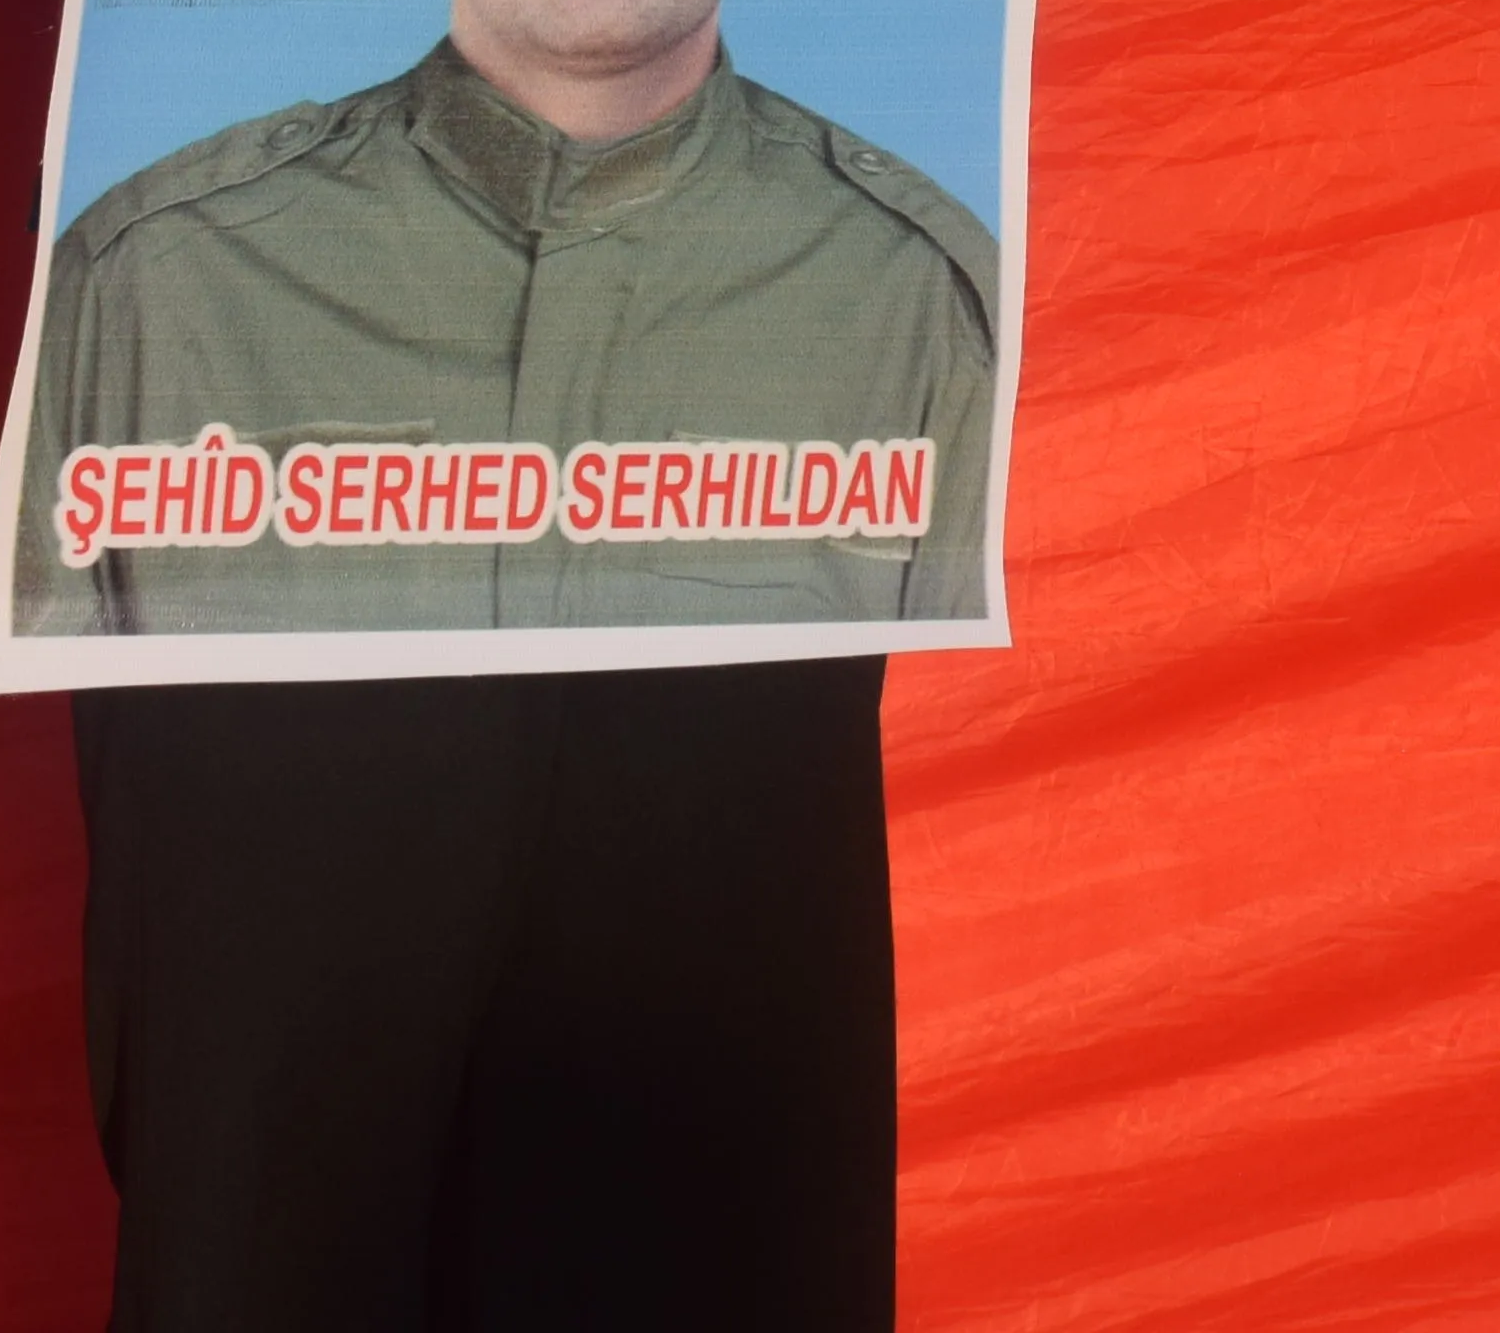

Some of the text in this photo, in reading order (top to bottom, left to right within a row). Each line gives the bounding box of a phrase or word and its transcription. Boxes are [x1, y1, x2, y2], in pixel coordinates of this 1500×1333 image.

[64, 436, 926, 556] ŞEHÎD SERHED SERHILDAN
